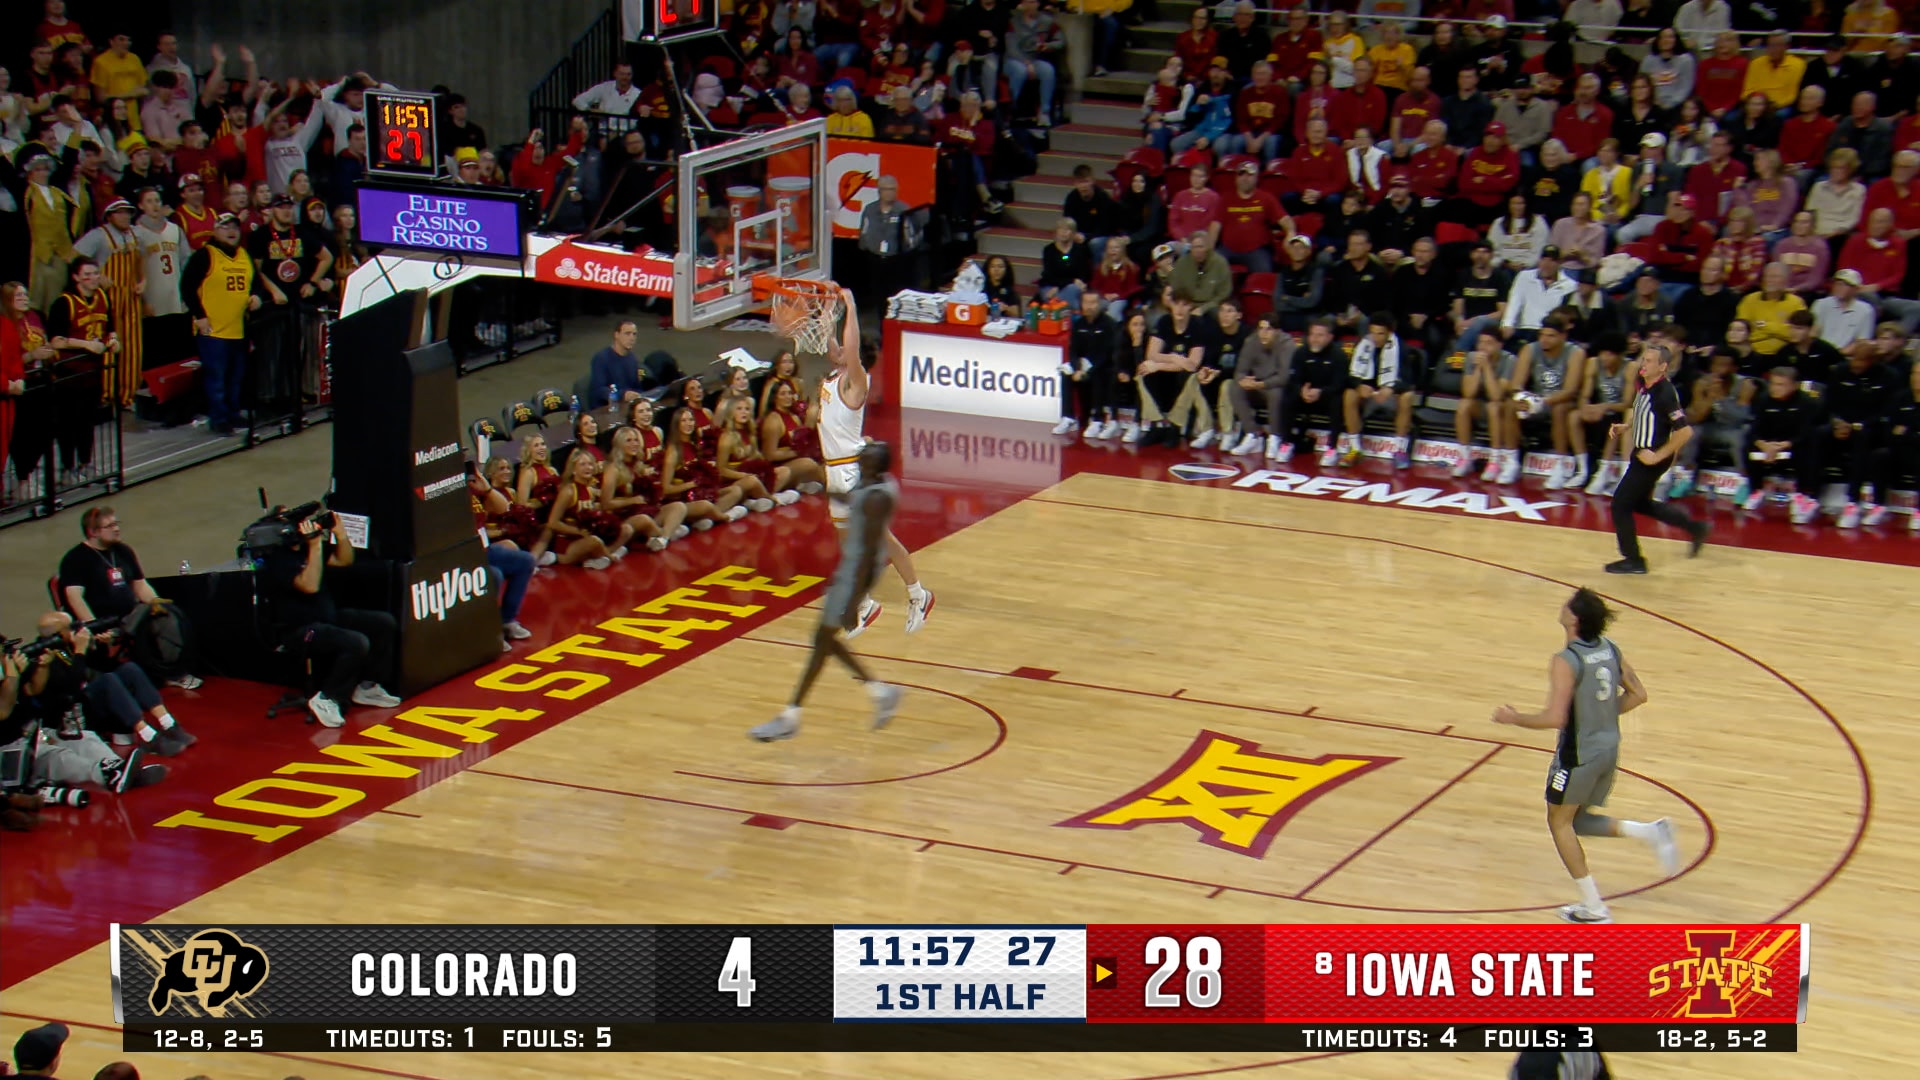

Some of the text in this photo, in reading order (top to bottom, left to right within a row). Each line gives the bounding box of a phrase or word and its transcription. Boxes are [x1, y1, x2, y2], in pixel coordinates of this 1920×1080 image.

[383, 104, 429, 129] 11:57
[387, 129, 423, 160] 27
[408, 194, 468, 216] ELITE
[396, 210, 481, 234] CASINO
[392, 225, 488, 250] RESORTS
[160, 254, 172, 275] 3
[226, 276, 246, 291] 25
[954, 304, 971, 321] G
[909, 354, 1056, 398] Mediacom
[415, 442, 460, 466] Mediacom
[1231, 469, 1568, 521] REMAX
[411, 566, 487, 622] HyVee
[1594, 666, 1613, 702] 3
[155, 565, 827, 843] IOWA STATE
